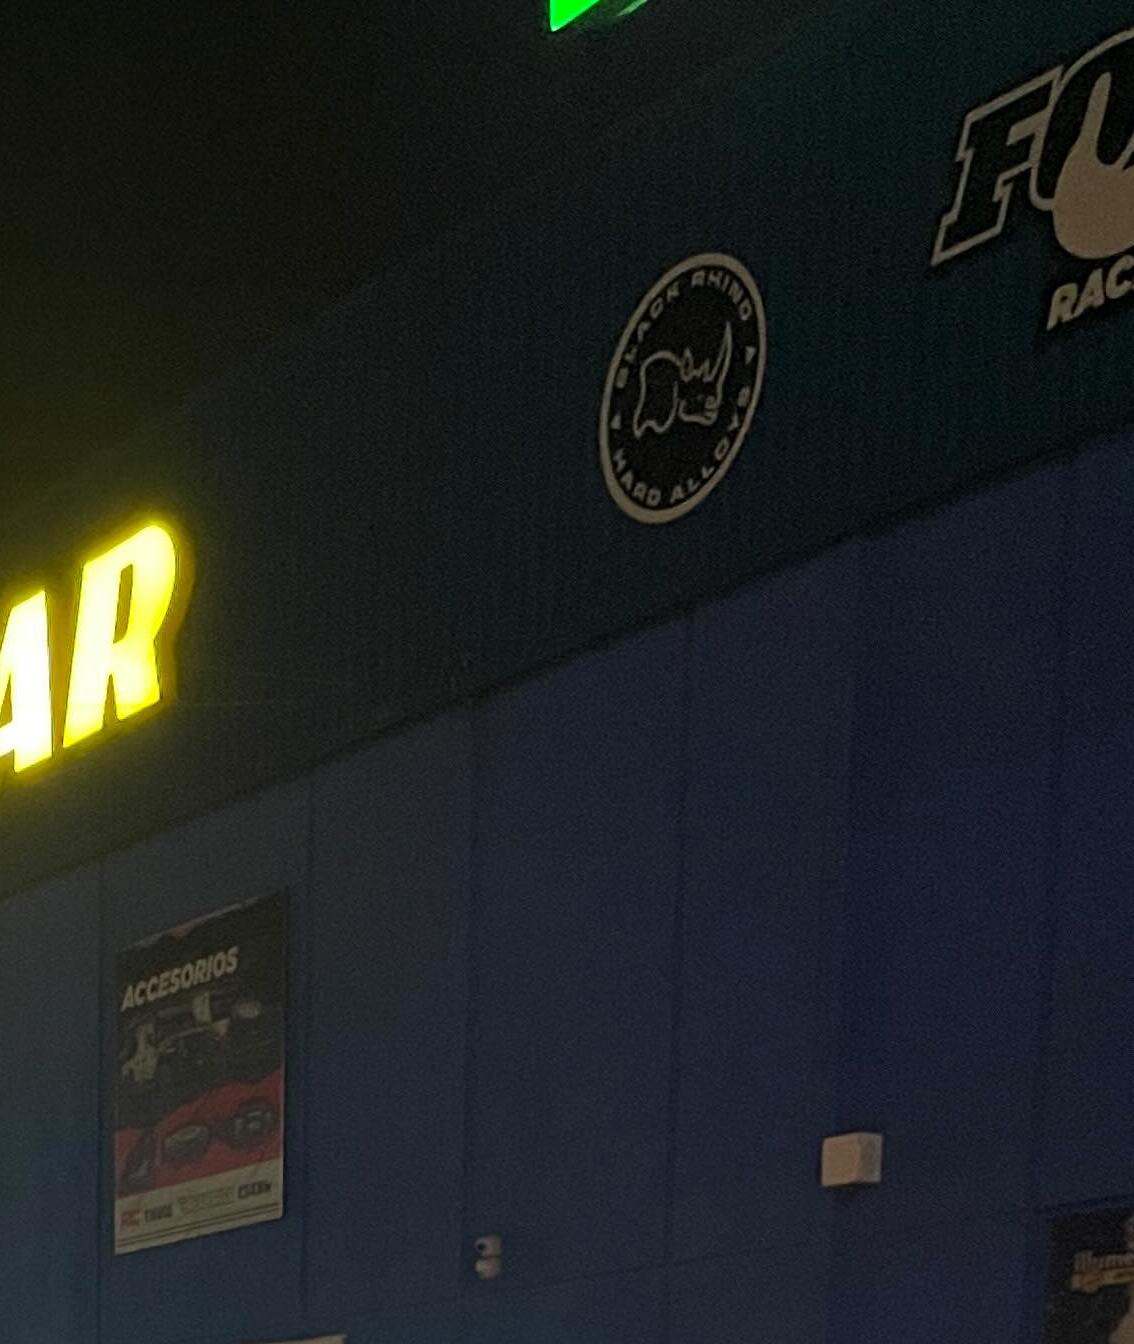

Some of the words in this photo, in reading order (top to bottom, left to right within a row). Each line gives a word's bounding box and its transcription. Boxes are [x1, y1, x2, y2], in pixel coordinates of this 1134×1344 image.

[690, 268, 754, 321] RHINO
[611, 446, 662, 508] HARD
[119, 945, 241, 1013] ACCESORIOS
